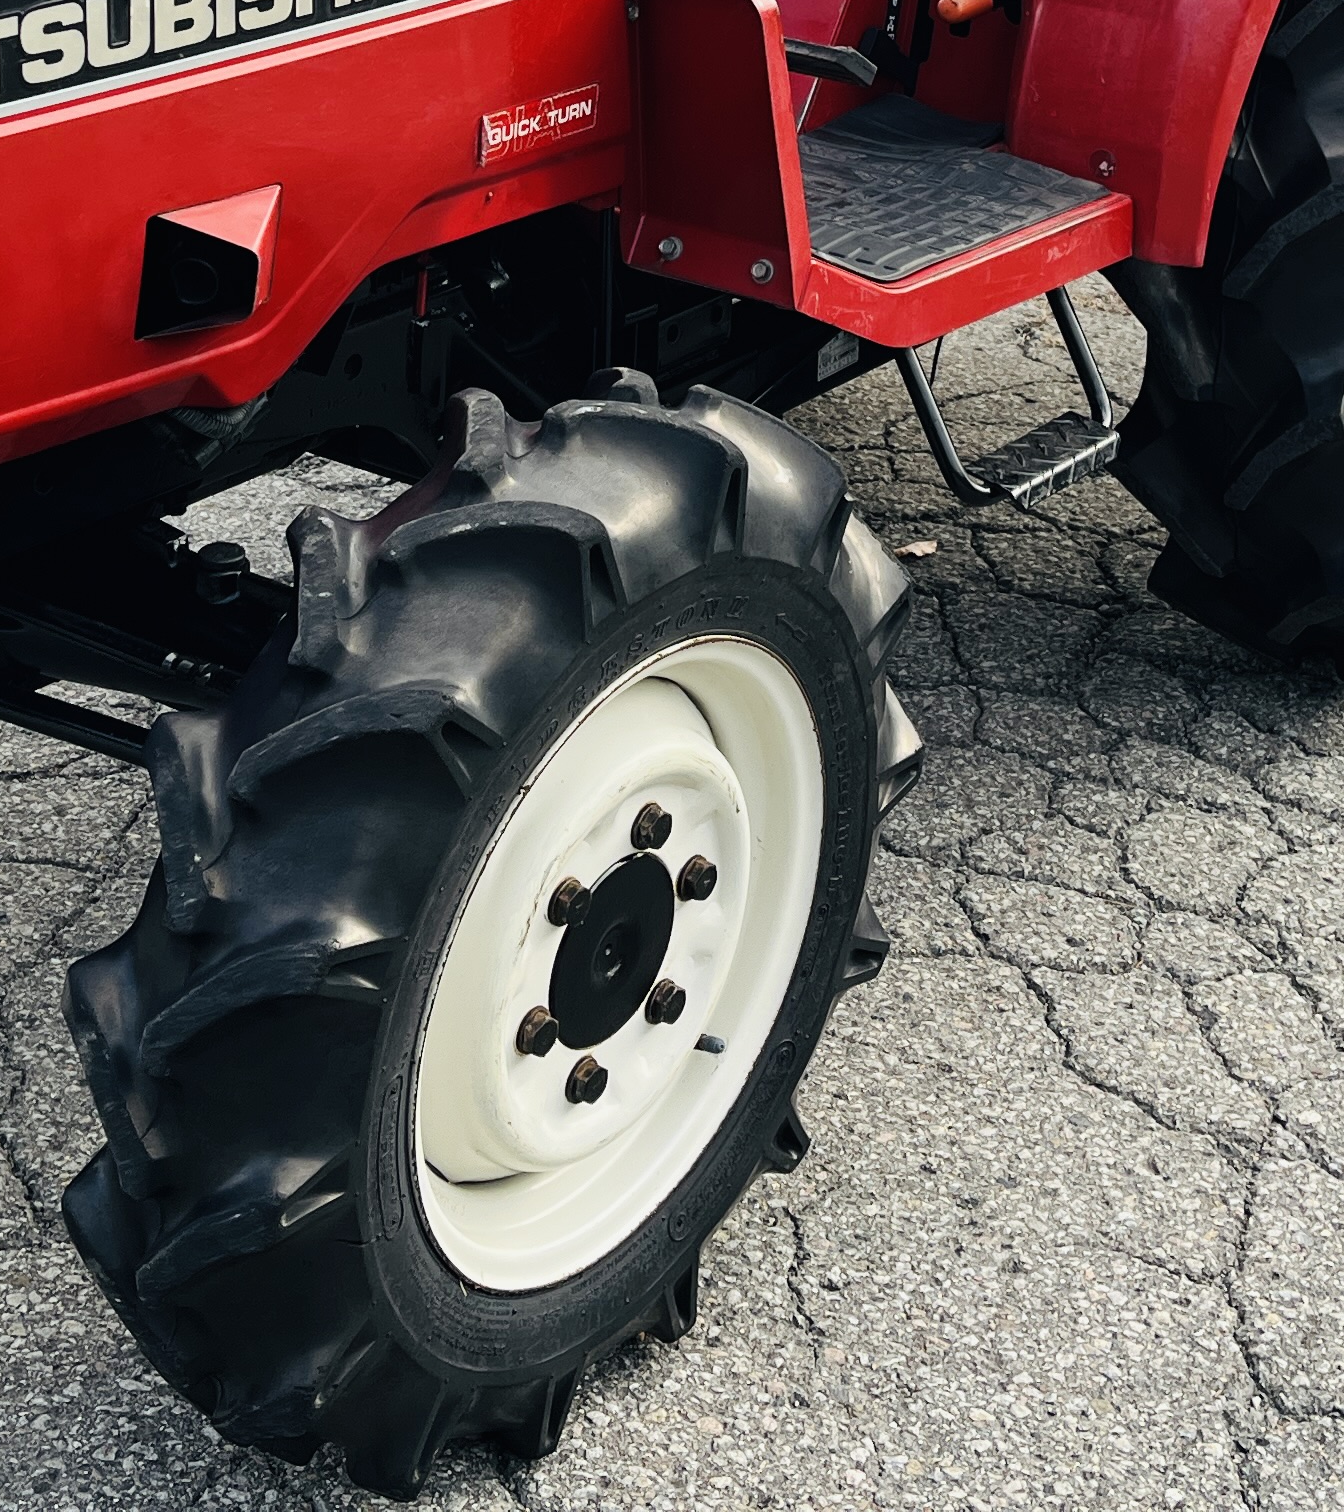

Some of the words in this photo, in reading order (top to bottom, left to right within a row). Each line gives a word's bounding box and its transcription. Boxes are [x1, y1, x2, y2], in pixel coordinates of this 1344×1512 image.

[487, 114, 541, 147] QUICK
[547, 98, 593, 127] TURN
[458, 595, 750, 877] BRIDGESTONE
